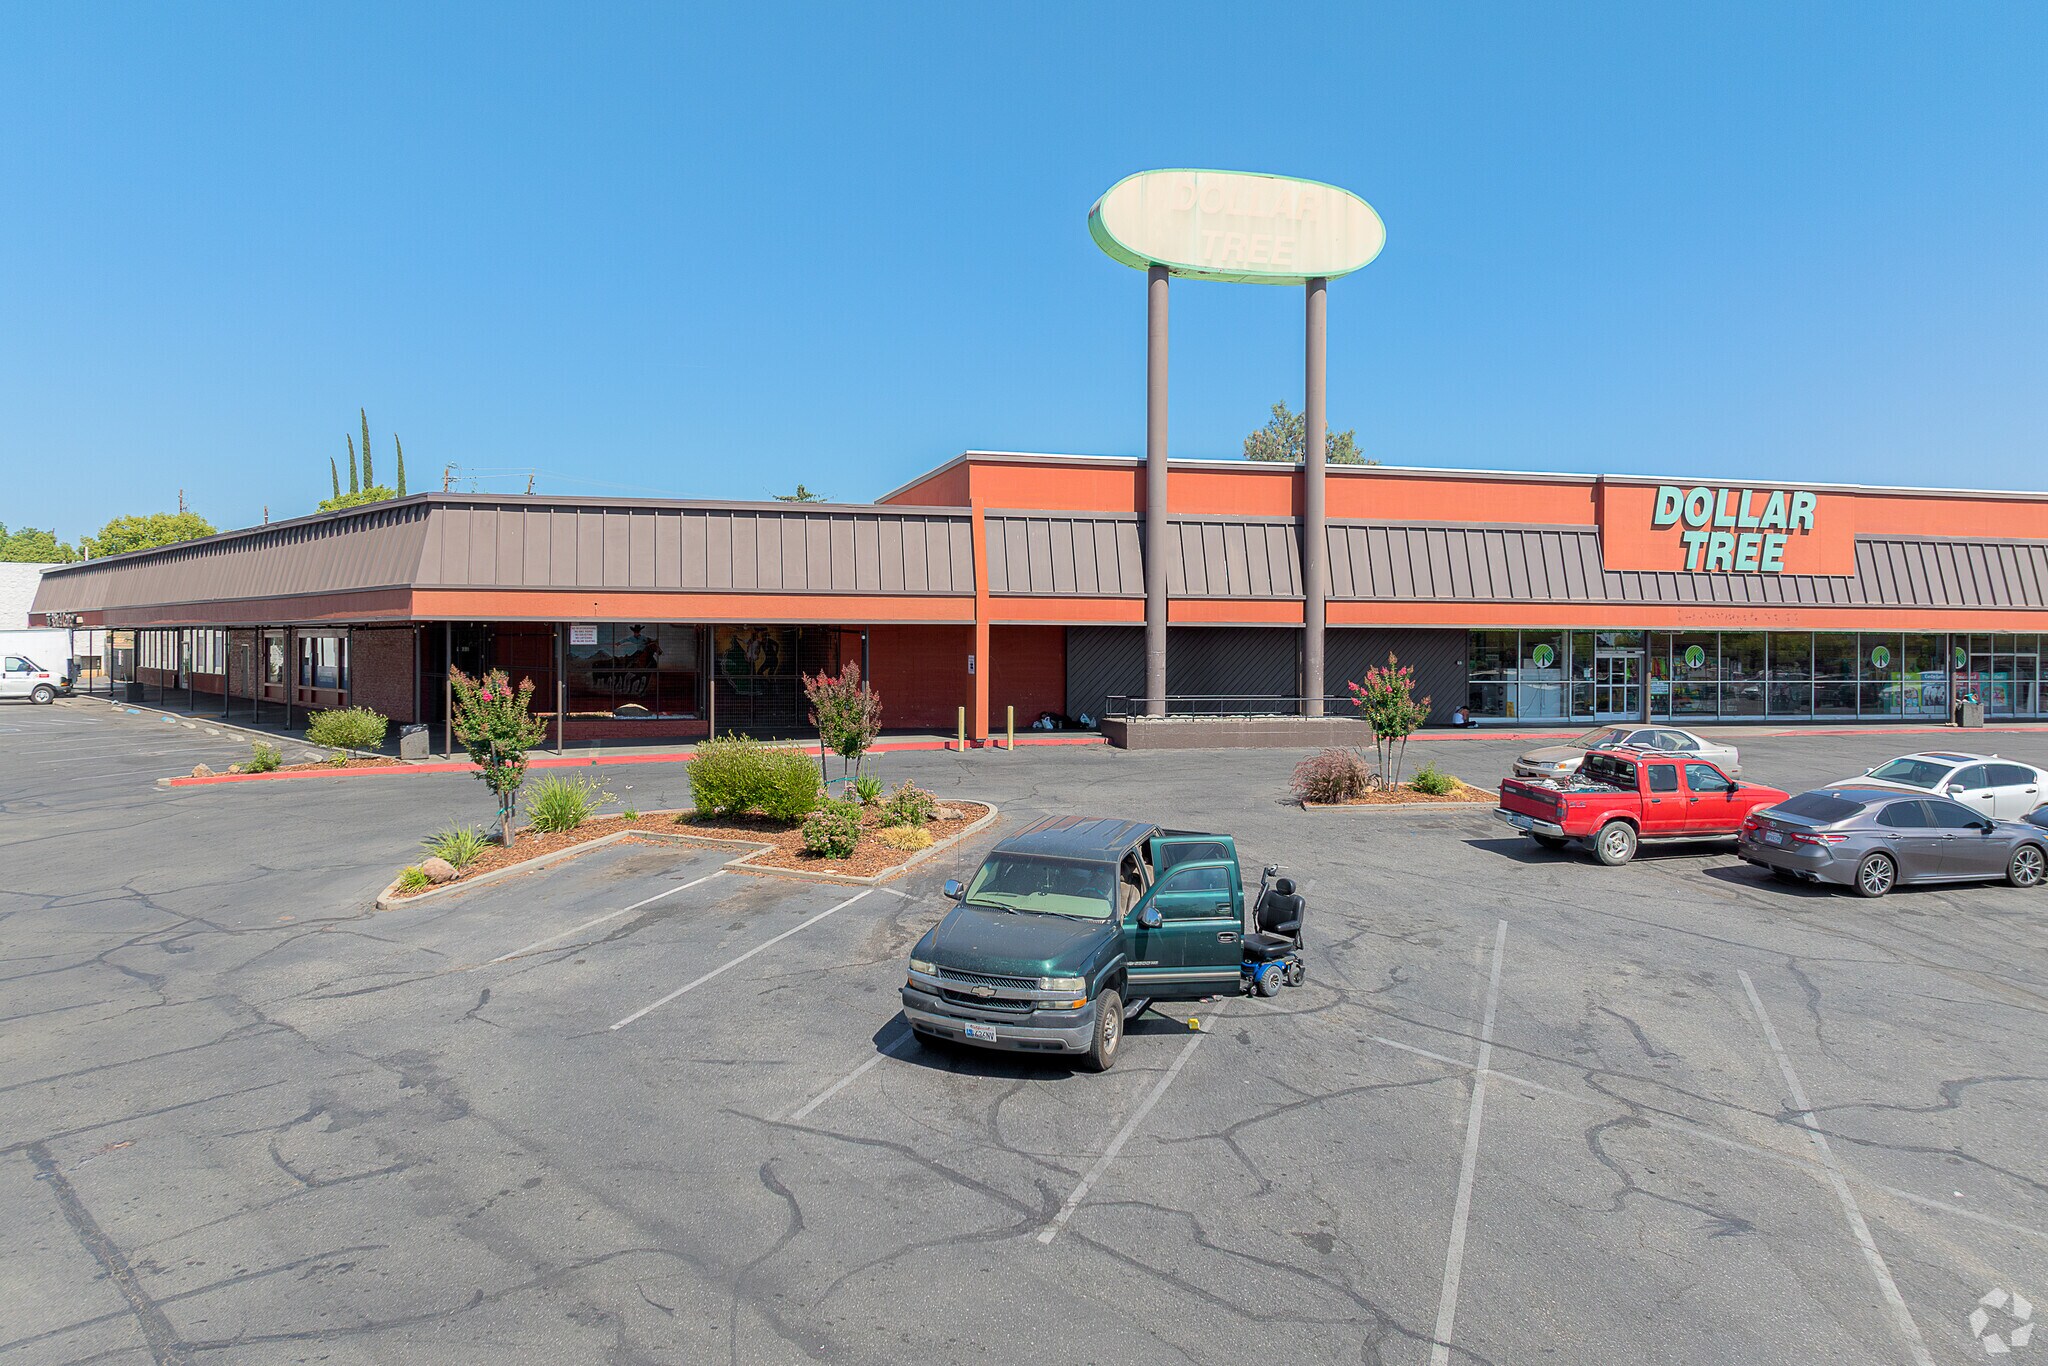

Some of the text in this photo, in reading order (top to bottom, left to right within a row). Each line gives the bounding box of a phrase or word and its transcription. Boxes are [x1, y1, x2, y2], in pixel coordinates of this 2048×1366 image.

[1172, 180, 1321, 221] DOLLAR
[1201, 230, 1296, 265] TREE
[1653, 486, 1817, 530] DOLLAR
[1682, 531, 1788, 572] TREE
